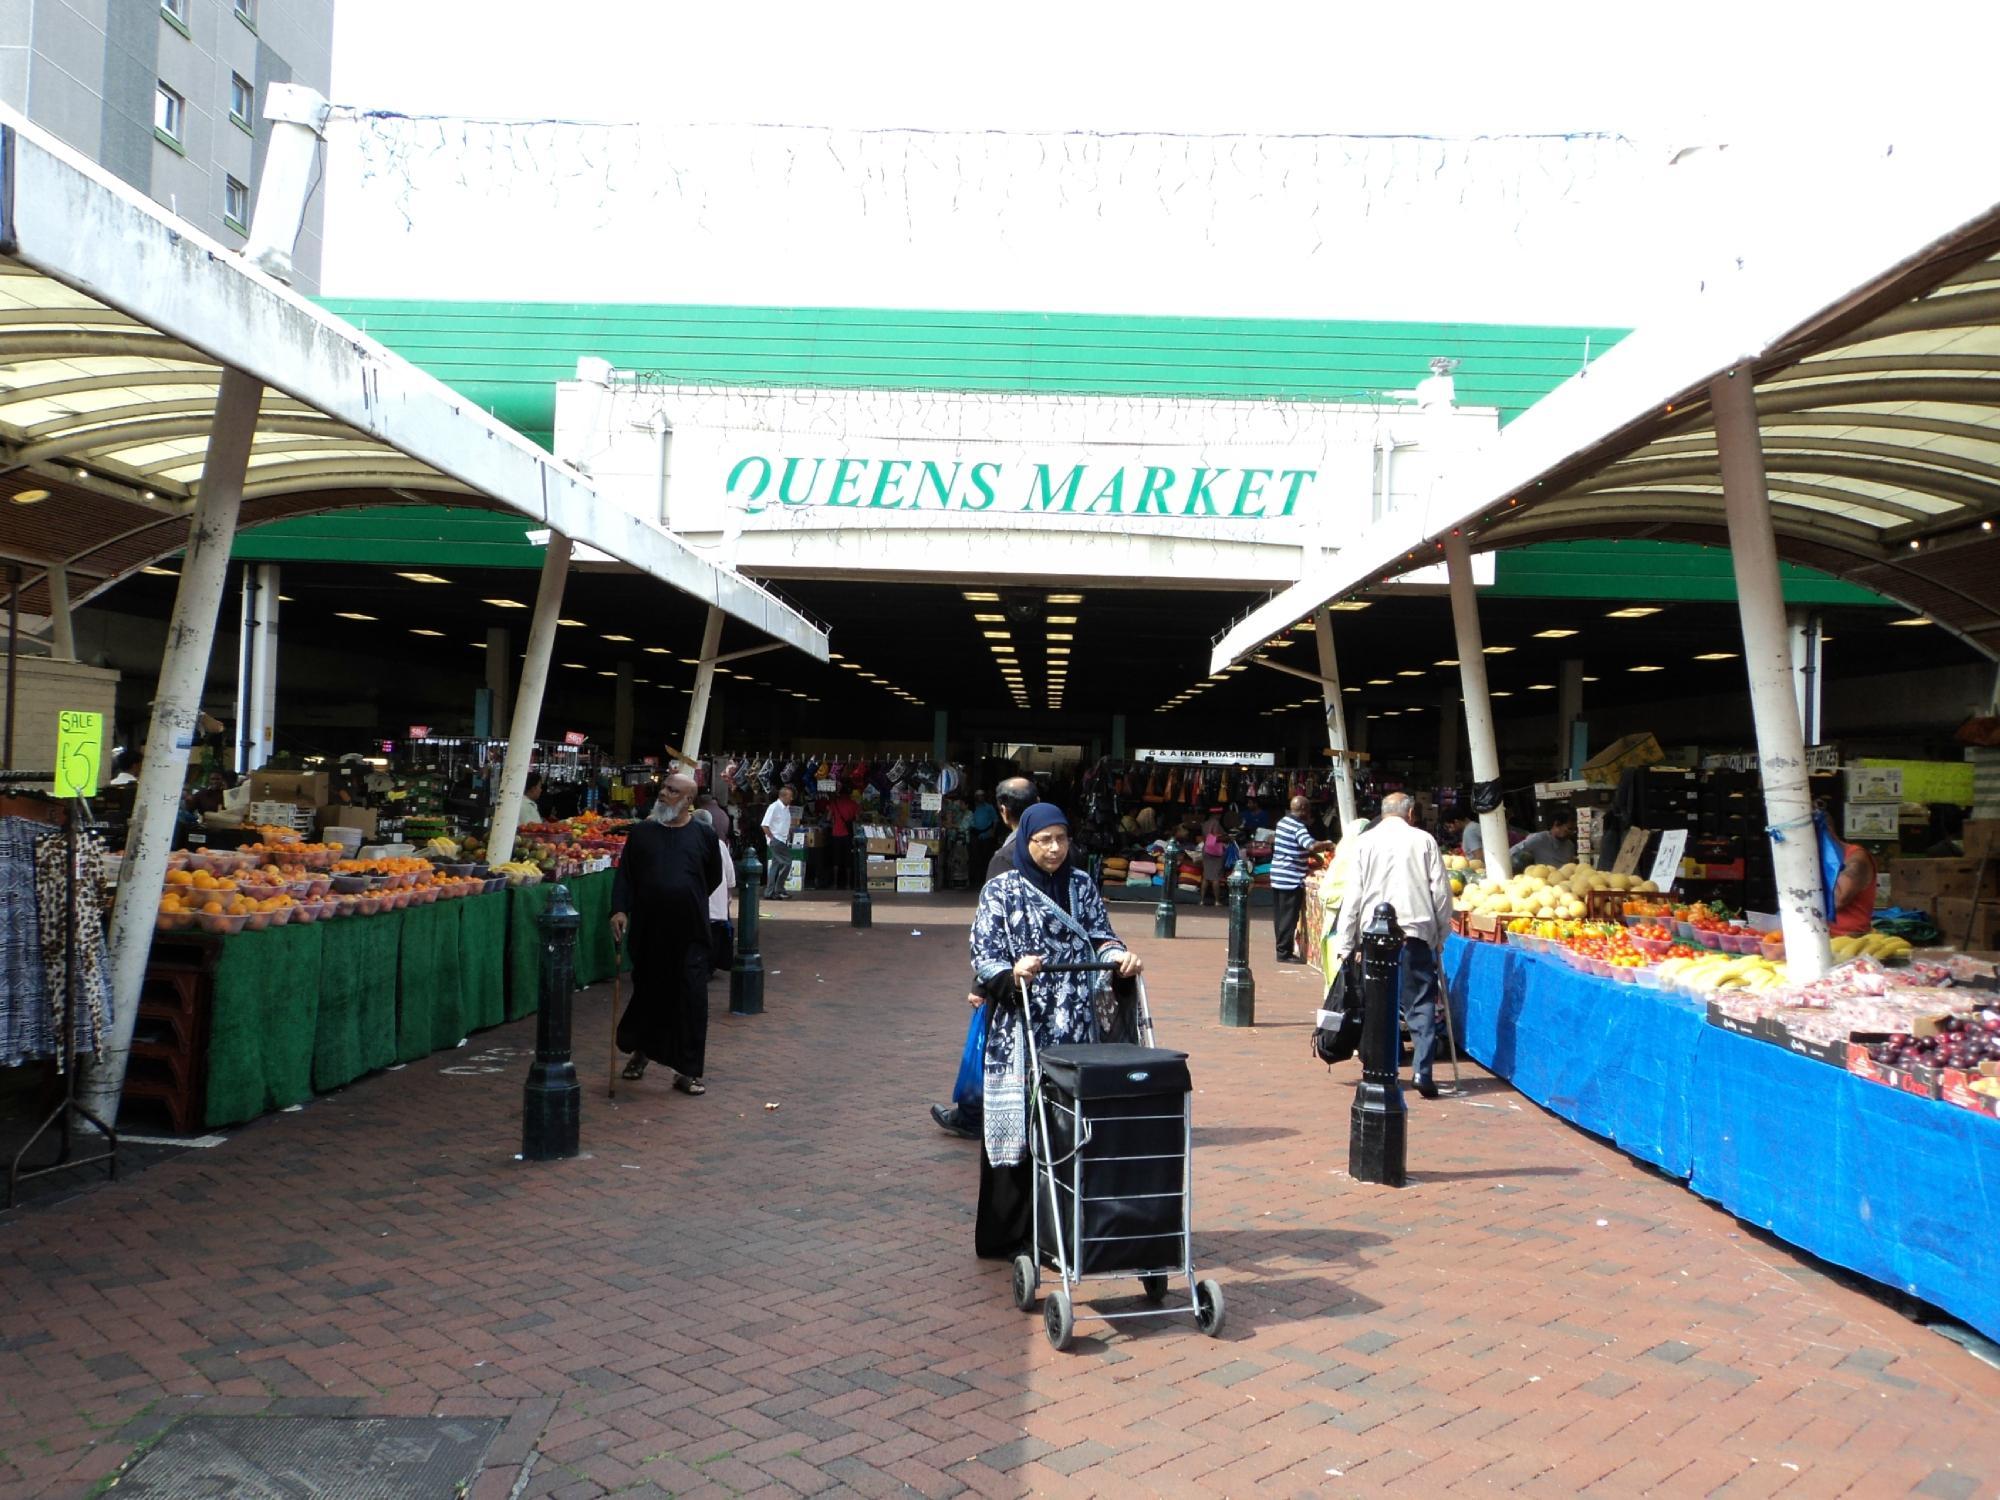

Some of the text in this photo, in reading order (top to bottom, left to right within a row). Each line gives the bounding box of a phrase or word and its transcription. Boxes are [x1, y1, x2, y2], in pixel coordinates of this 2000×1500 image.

[726, 455, 1317, 517] QUEENS MARKET
[61, 712, 94, 732] SALE
[1180, 751, 1264, 759] HABERDASHERY
